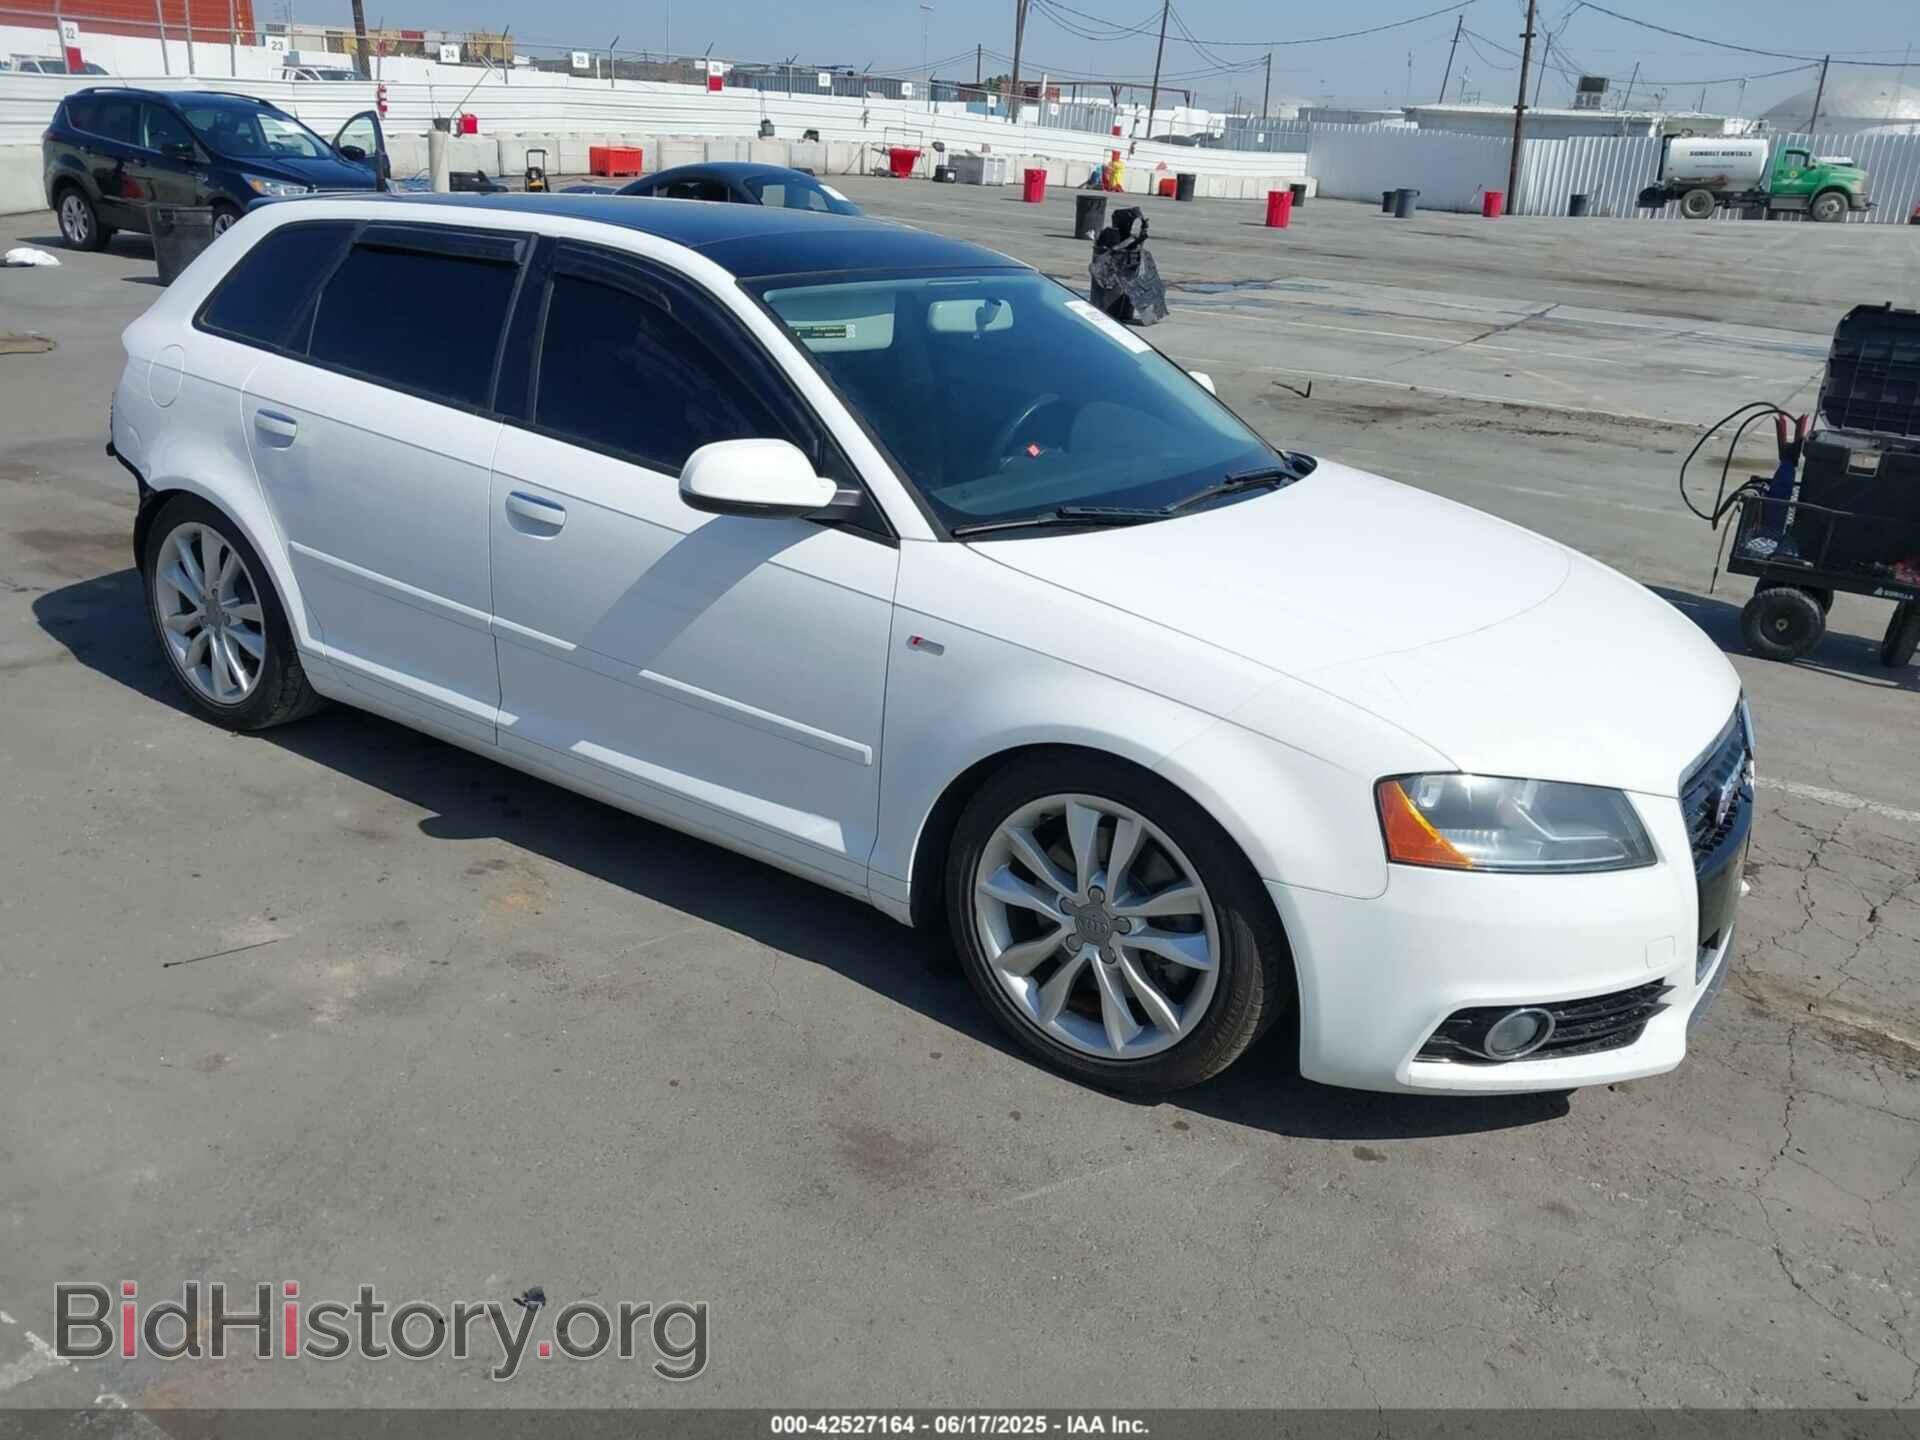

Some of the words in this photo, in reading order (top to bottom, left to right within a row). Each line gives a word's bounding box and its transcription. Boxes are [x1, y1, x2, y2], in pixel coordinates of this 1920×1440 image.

[65, 27, 76, 39] 22
[271, 40, 284, 51] 23
[445, 48, 456, 59] 24
